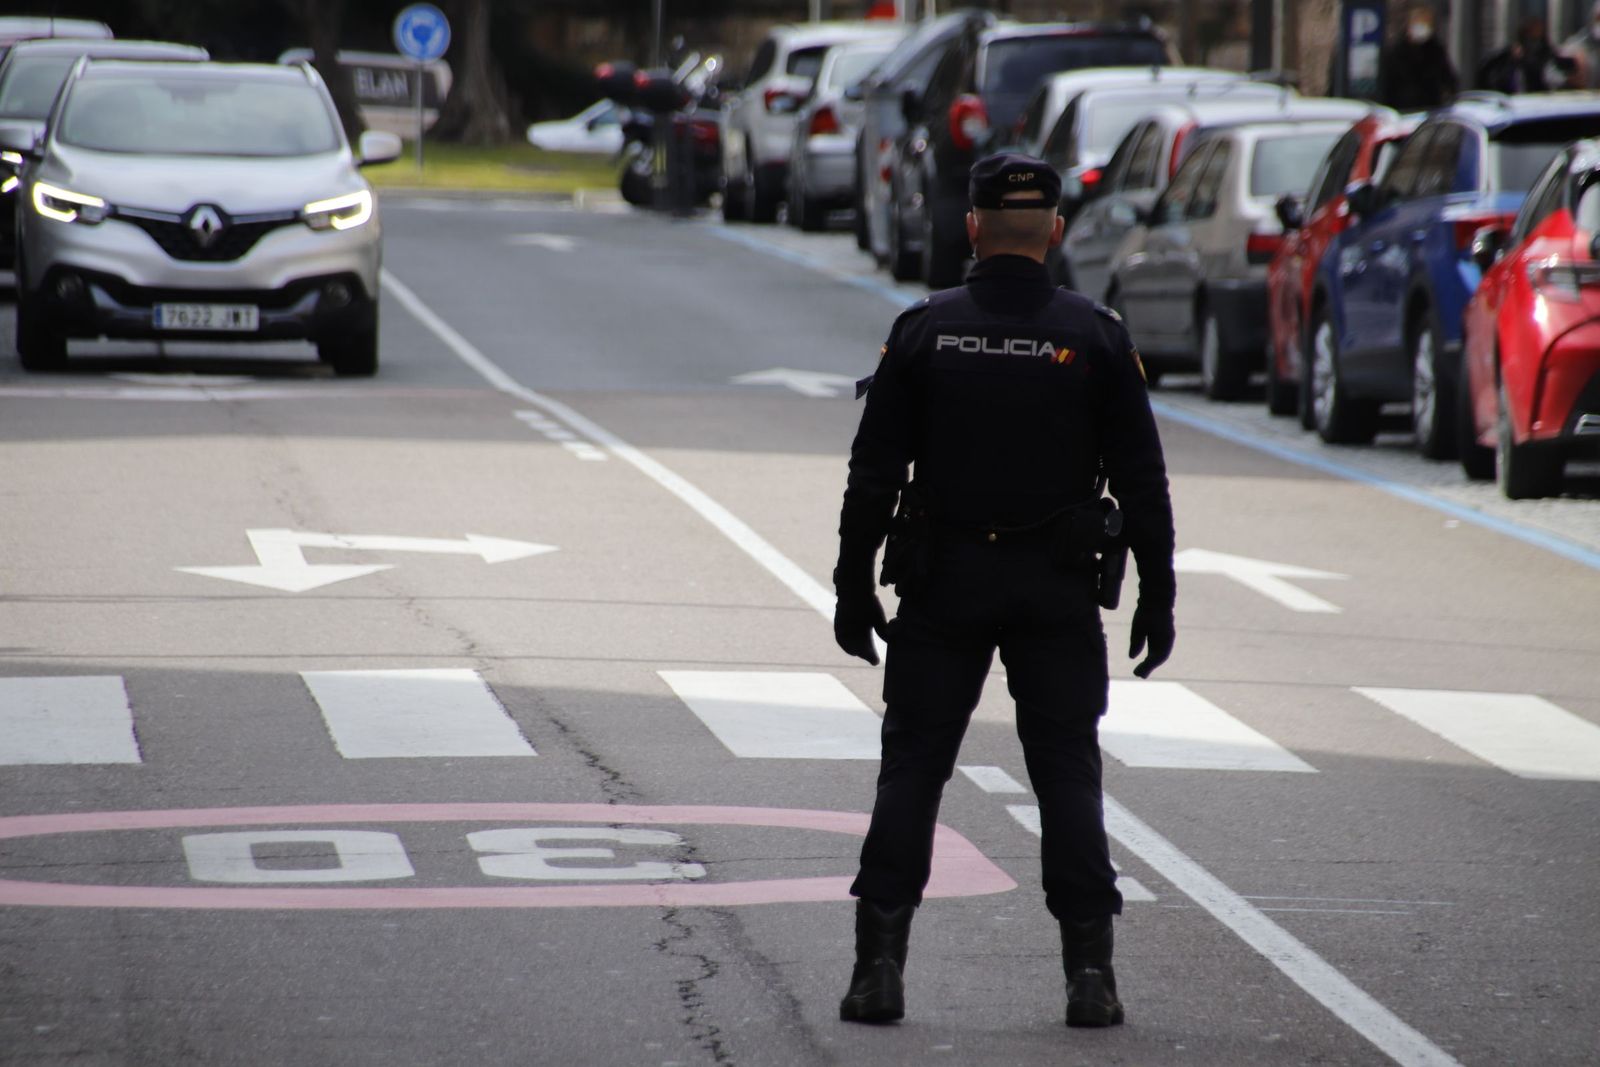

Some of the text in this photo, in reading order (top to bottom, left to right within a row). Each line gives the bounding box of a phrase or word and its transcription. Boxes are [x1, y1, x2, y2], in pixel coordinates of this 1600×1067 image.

[1351, 8, 1380, 46] P
[1008, 172, 1035, 182] CNP
[936, 335, 1057, 357] POLICIA
[182, 828, 707, 883] 30
